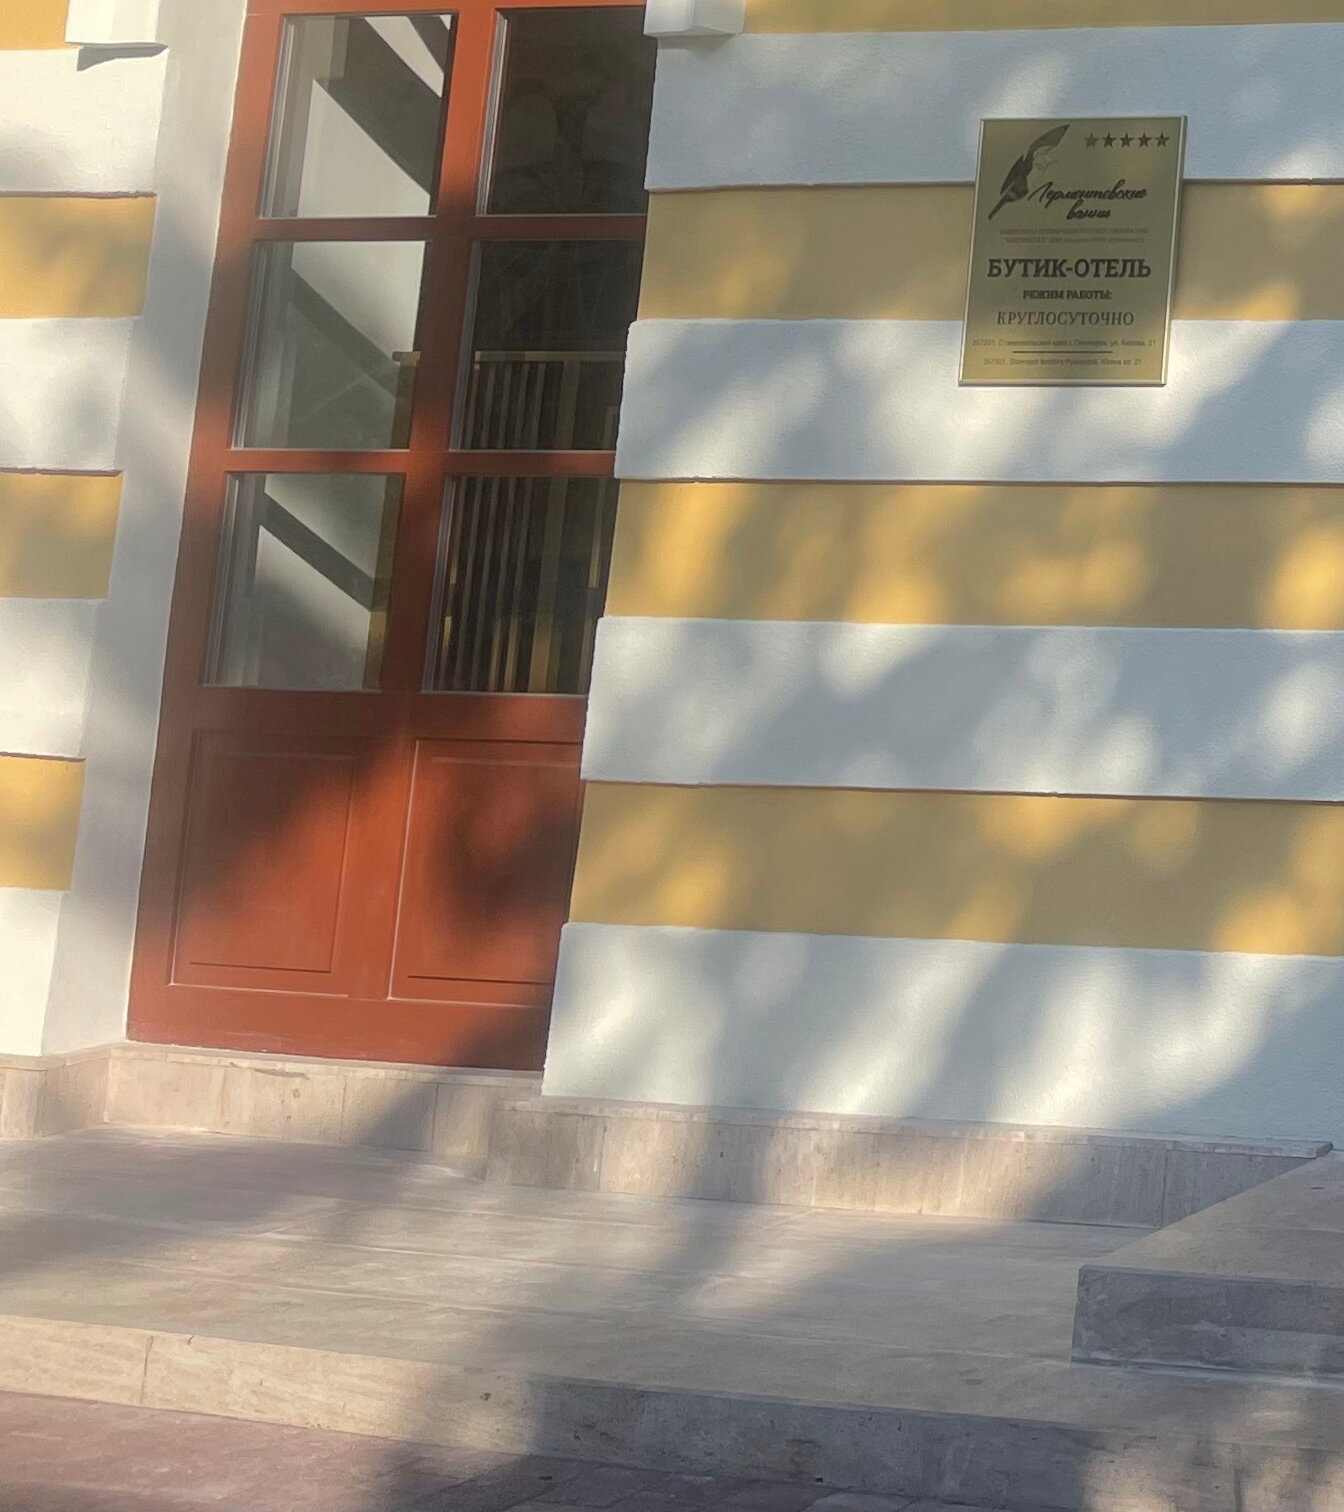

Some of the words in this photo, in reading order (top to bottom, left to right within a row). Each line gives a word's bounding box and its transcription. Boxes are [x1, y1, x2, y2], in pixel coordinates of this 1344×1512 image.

[987, 258, 1152, 278] БУТИК-ОТЕЛЬ
[1022, 289, 1065, 300] РЕЖИМ
[997, 311, 1135, 326] КРУГЛОСУТОЧНО
